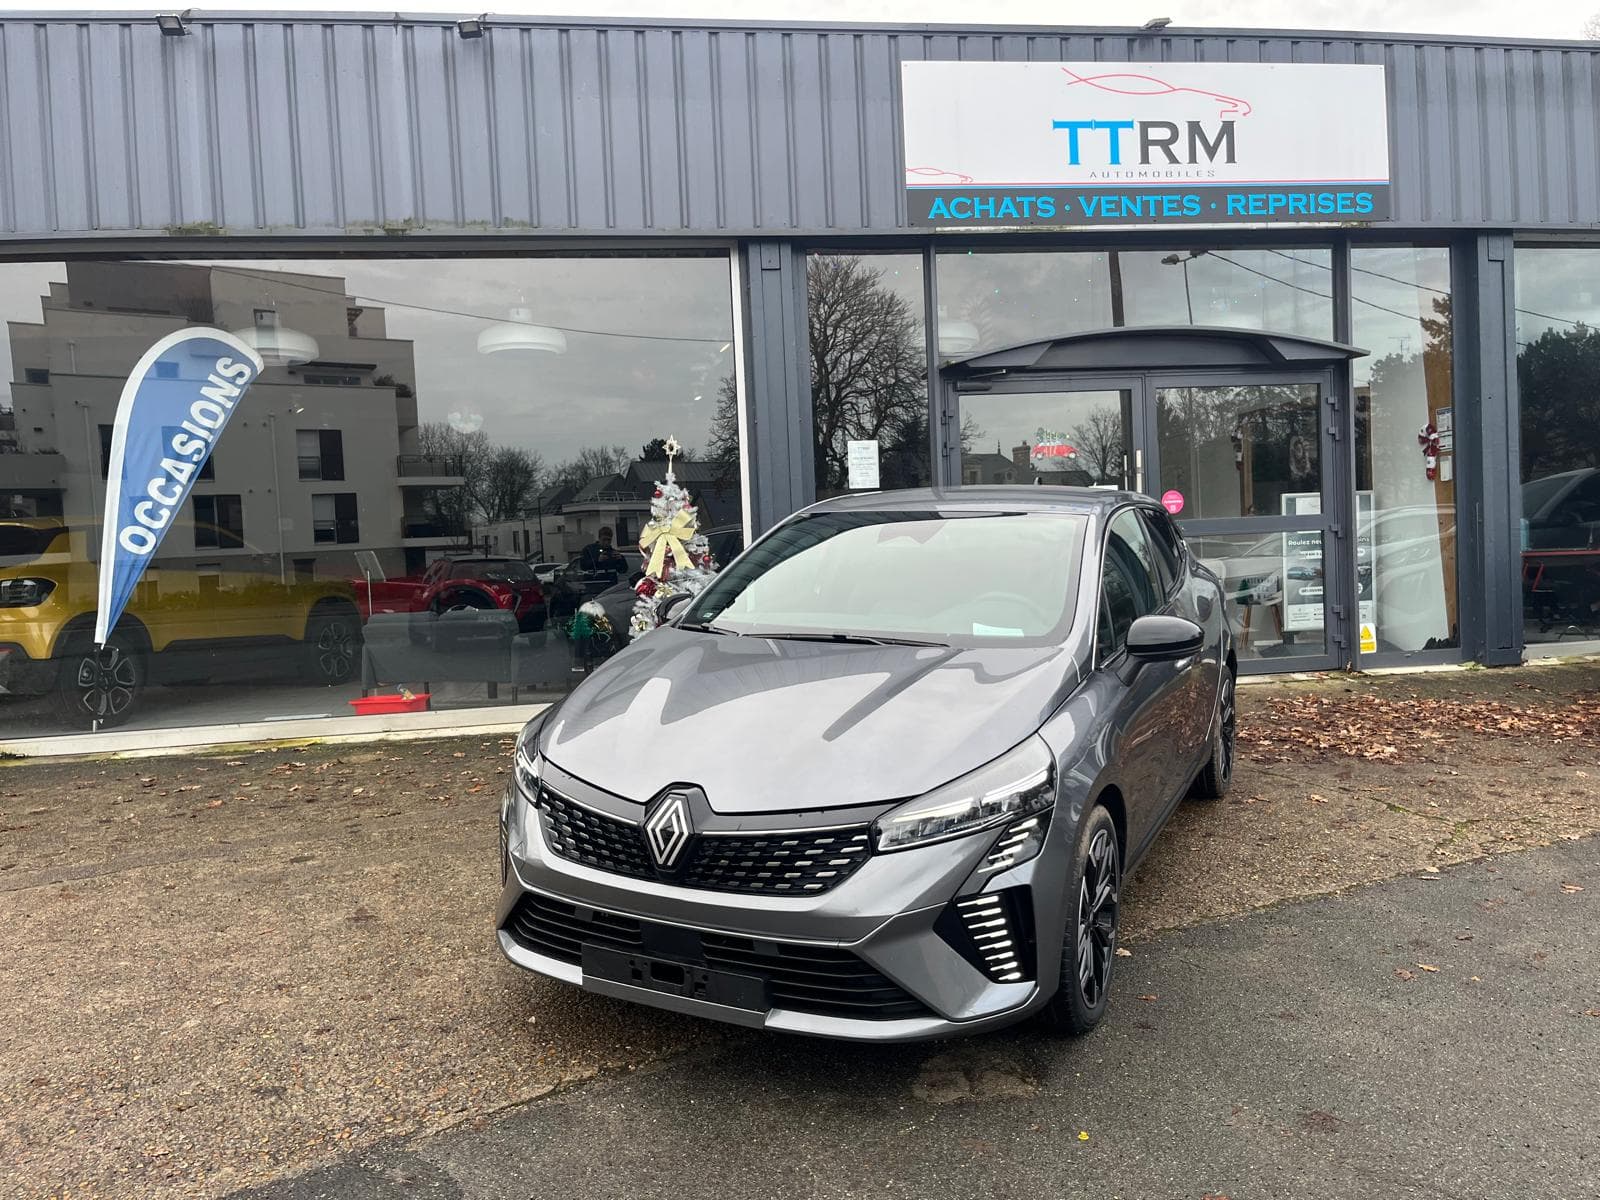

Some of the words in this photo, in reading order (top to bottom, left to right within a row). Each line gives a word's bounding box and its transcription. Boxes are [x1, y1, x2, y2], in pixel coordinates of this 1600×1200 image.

[1052, 119, 1237, 165] TTRM
[1089, 169, 1216, 179] AUTOMOBILES
[928, 196, 1055, 219] ACHATS
[1079, 194, 1201, 217] VENTES
[1227, 192, 1374, 215] REPRISES
[119, 357, 252, 555] OCCASIONS
